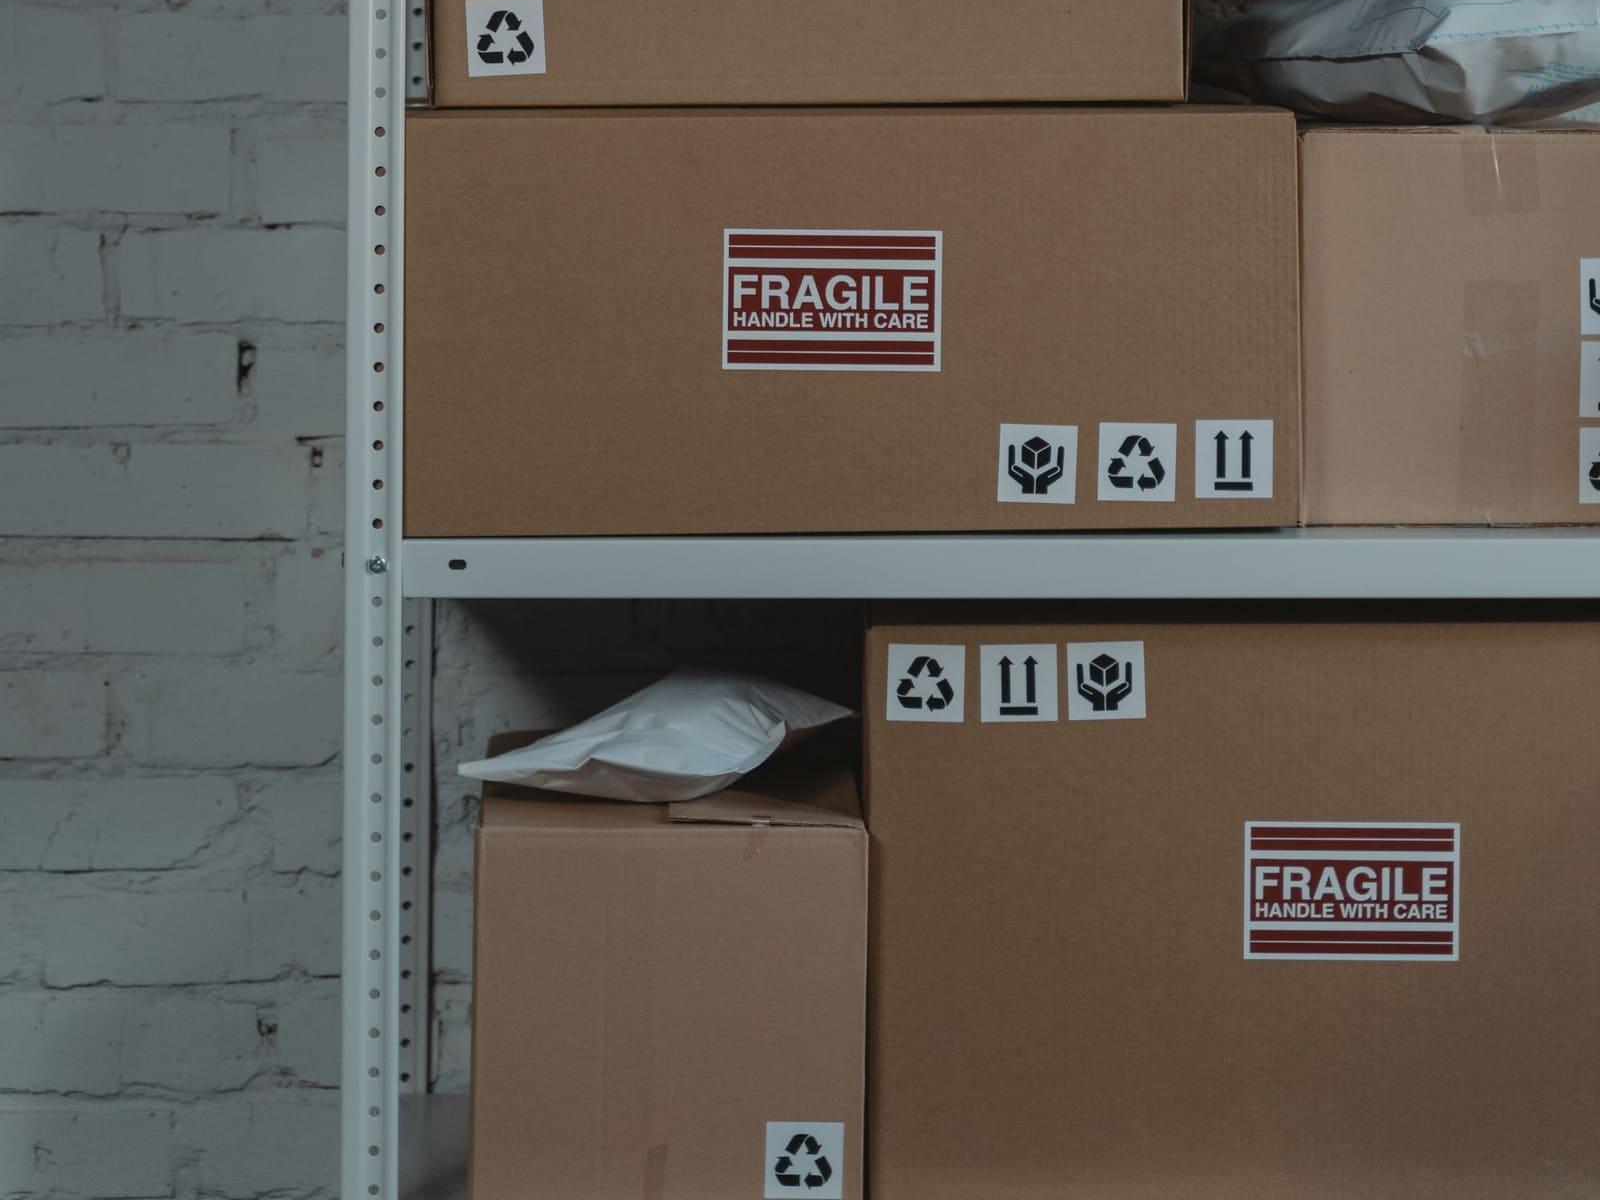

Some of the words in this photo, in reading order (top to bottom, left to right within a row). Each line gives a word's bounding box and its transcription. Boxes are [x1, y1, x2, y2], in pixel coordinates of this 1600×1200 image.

[734, 275, 929, 310] FRAGILE
[734, 312, 813, 327] HANDLE
[819, 313, 867, 328] WITH
[874, 313, 928, 328] CARE
[1256, 866, 1448, 901] FRAGILE
[1256, 903, 1334, 918] HANDLE
[1340, 904, 1388, 918] WITH
[1394, 904, 1447, 919] CARE
